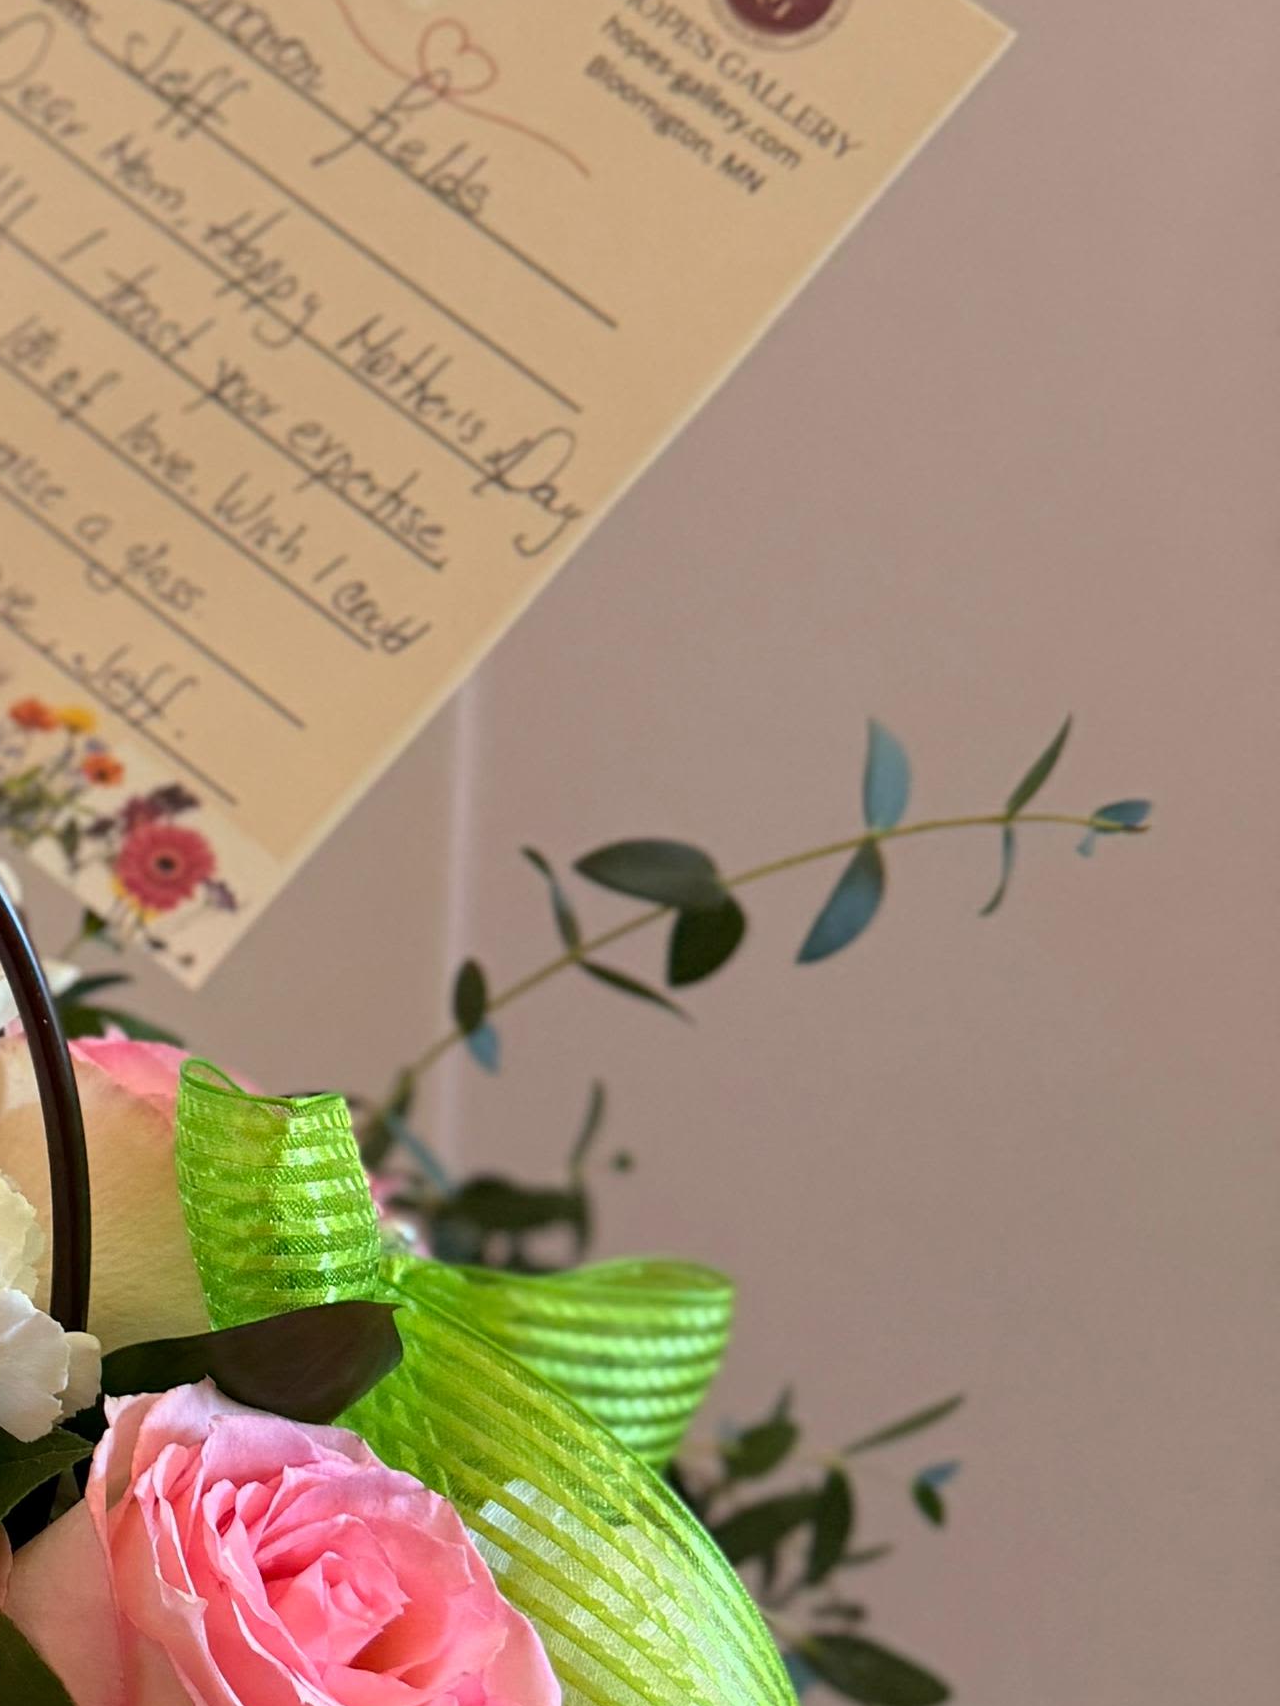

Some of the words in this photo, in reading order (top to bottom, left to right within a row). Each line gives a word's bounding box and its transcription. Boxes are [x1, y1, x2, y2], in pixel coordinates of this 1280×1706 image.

[714, 46, 864, 162] GALLERY
[714, 151, 767, 195] MN
[206, 209, 320, 347] Happy
[471, 429, 580, 559] Day
[48, 366, 121, 421] of
[211, 471, 307, 567] Wish
